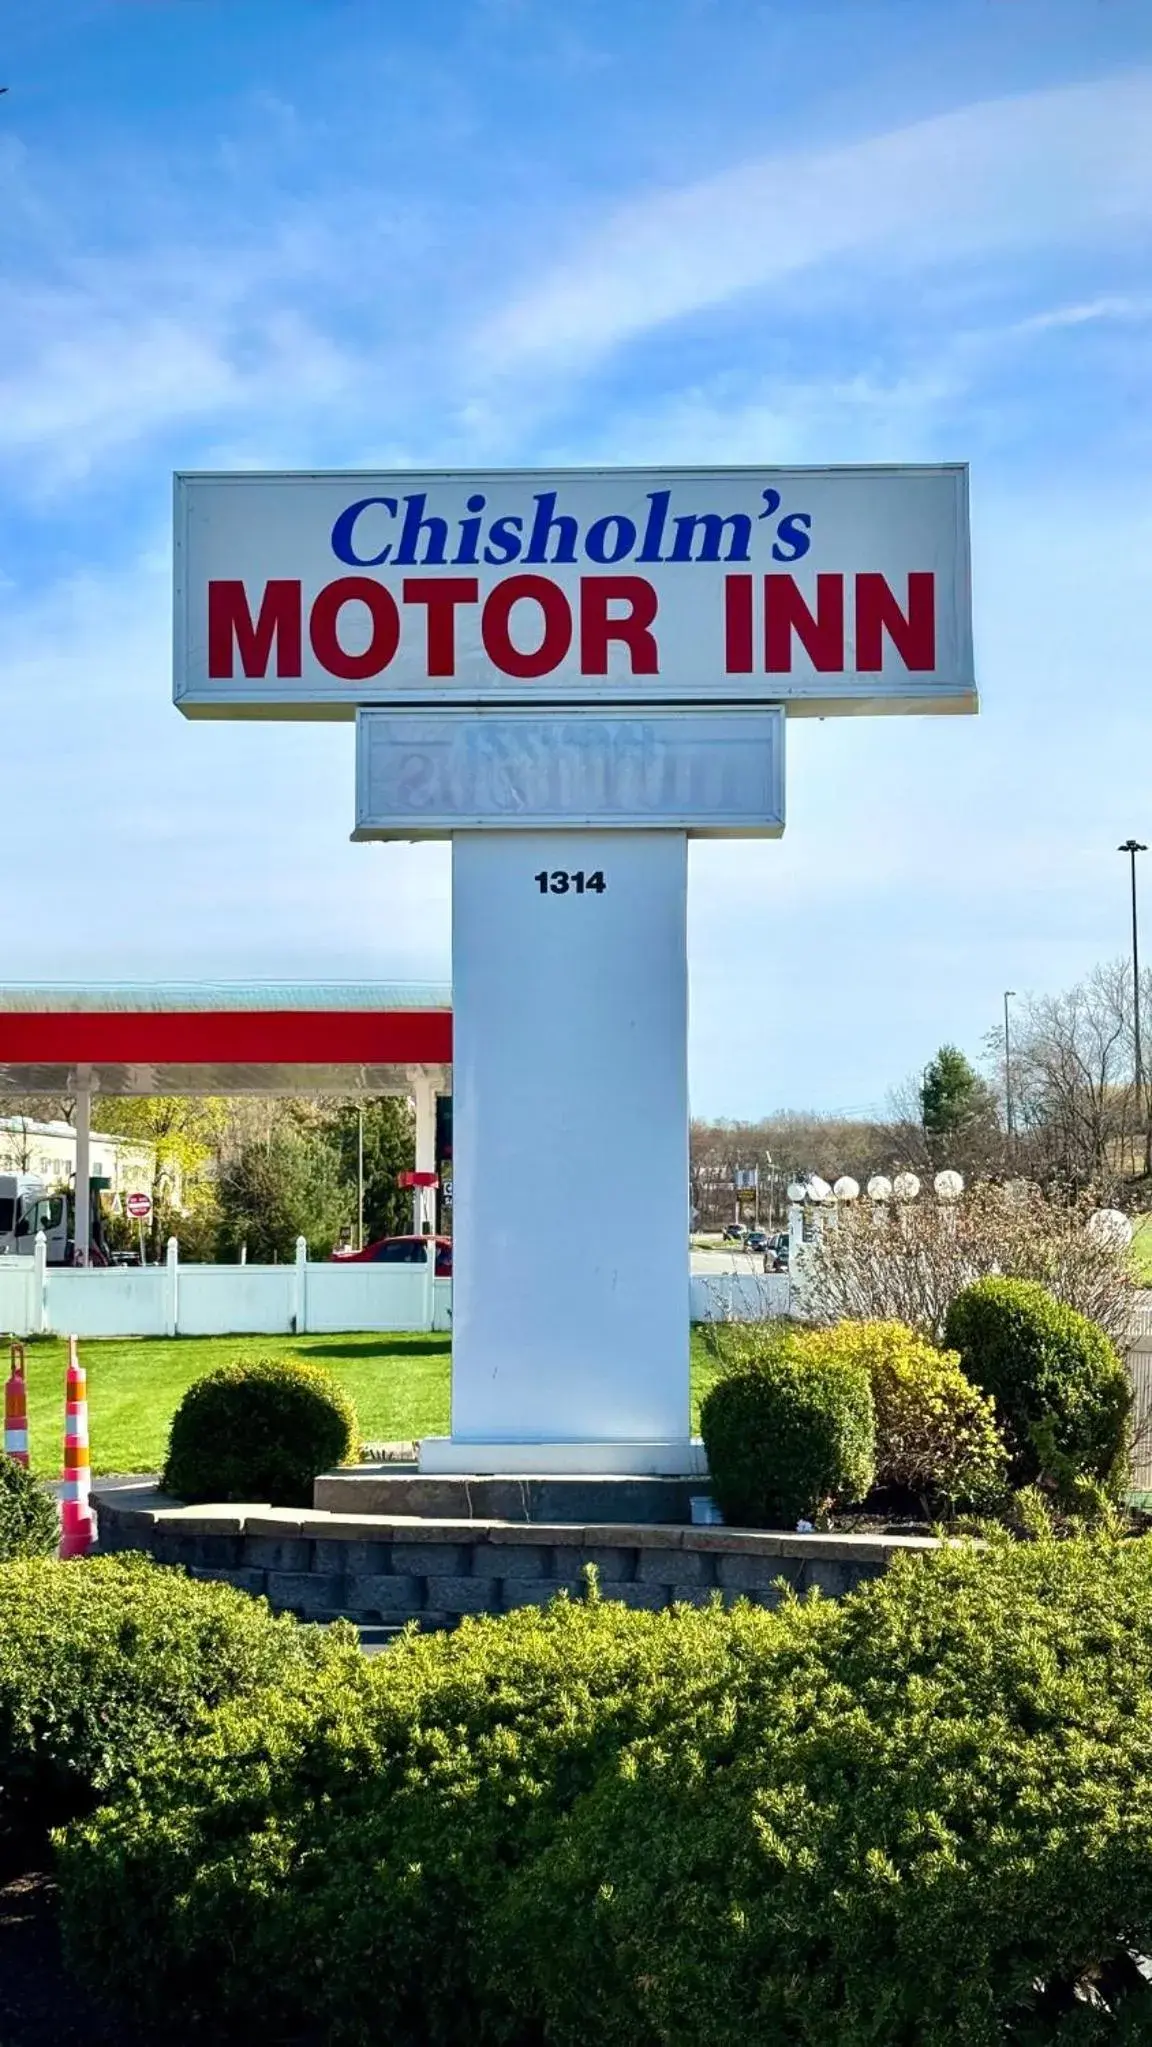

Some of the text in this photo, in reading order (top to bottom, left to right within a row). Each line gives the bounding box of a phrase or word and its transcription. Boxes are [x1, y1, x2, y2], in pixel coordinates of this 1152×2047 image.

[331, 488, 812, 566] Chisholm's
[208, 572, 935, 678] MOTOR INN
[534, 872, 607, 894] 1314
